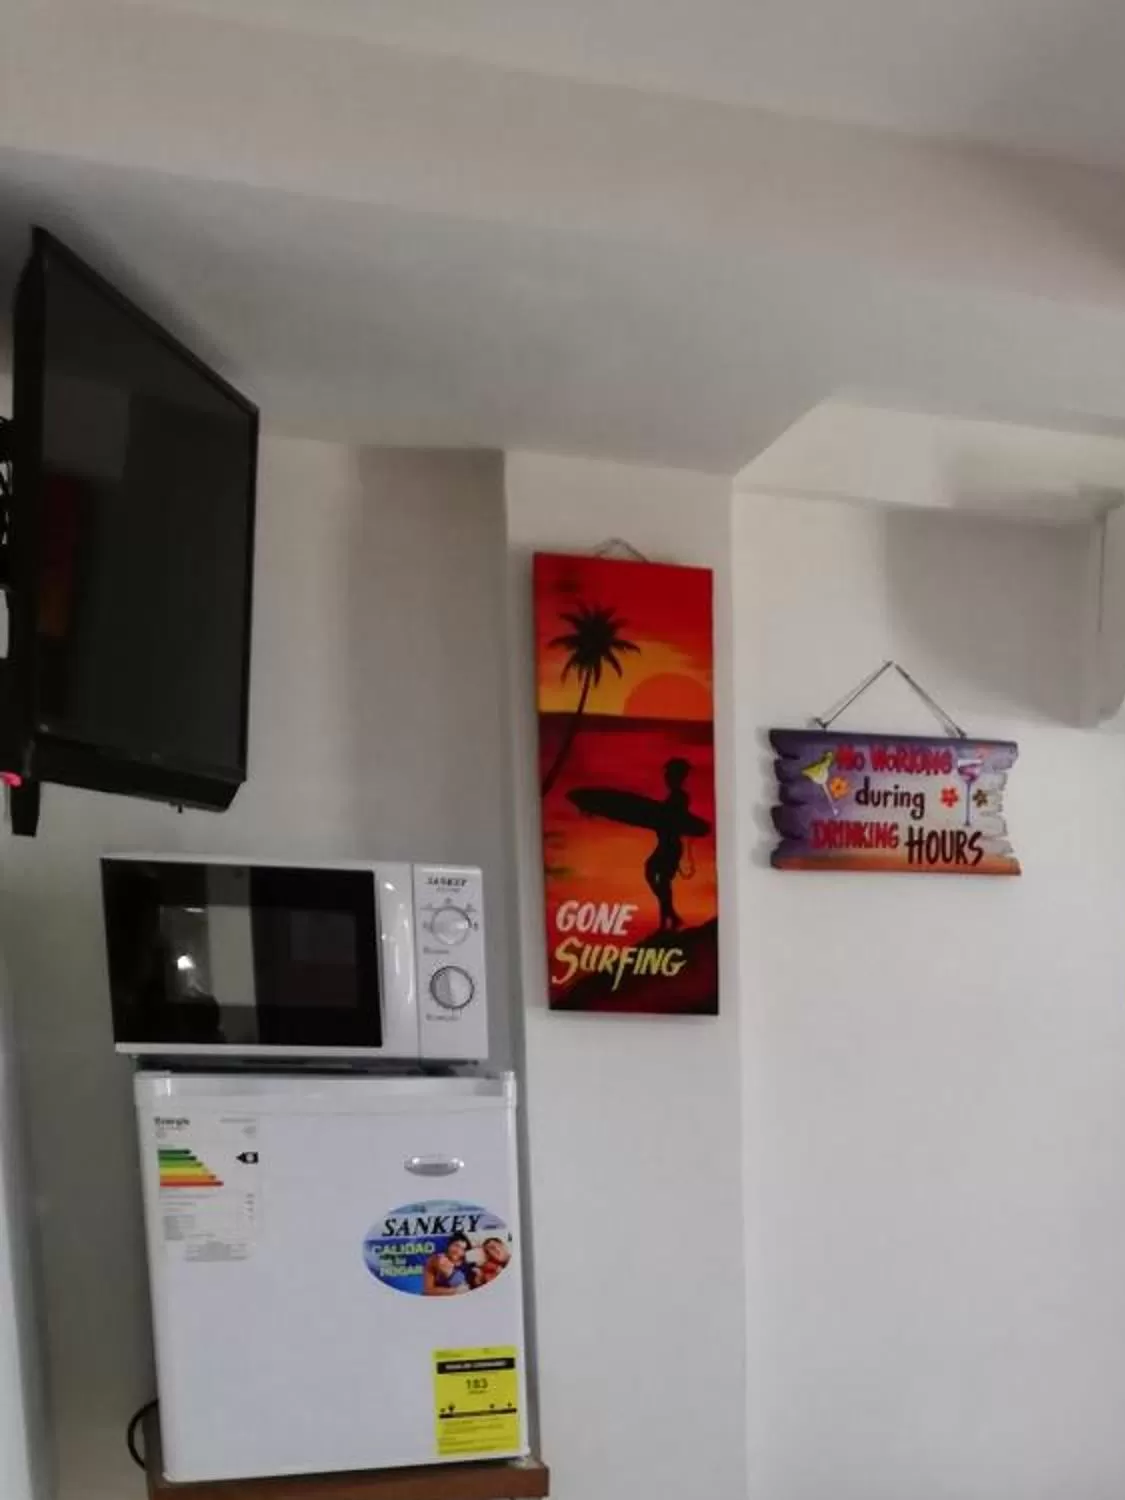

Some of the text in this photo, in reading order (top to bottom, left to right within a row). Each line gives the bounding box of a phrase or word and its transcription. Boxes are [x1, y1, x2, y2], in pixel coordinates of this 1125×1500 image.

[854, 776, 926, 821] during
[809, 820, 985, 867] DRINKING HOURS
[555, 900, 640, 937] GONE
[382, 1214, 482, 1237] SANKEY
[371, 1240, 436, 1256] CALIDAD
